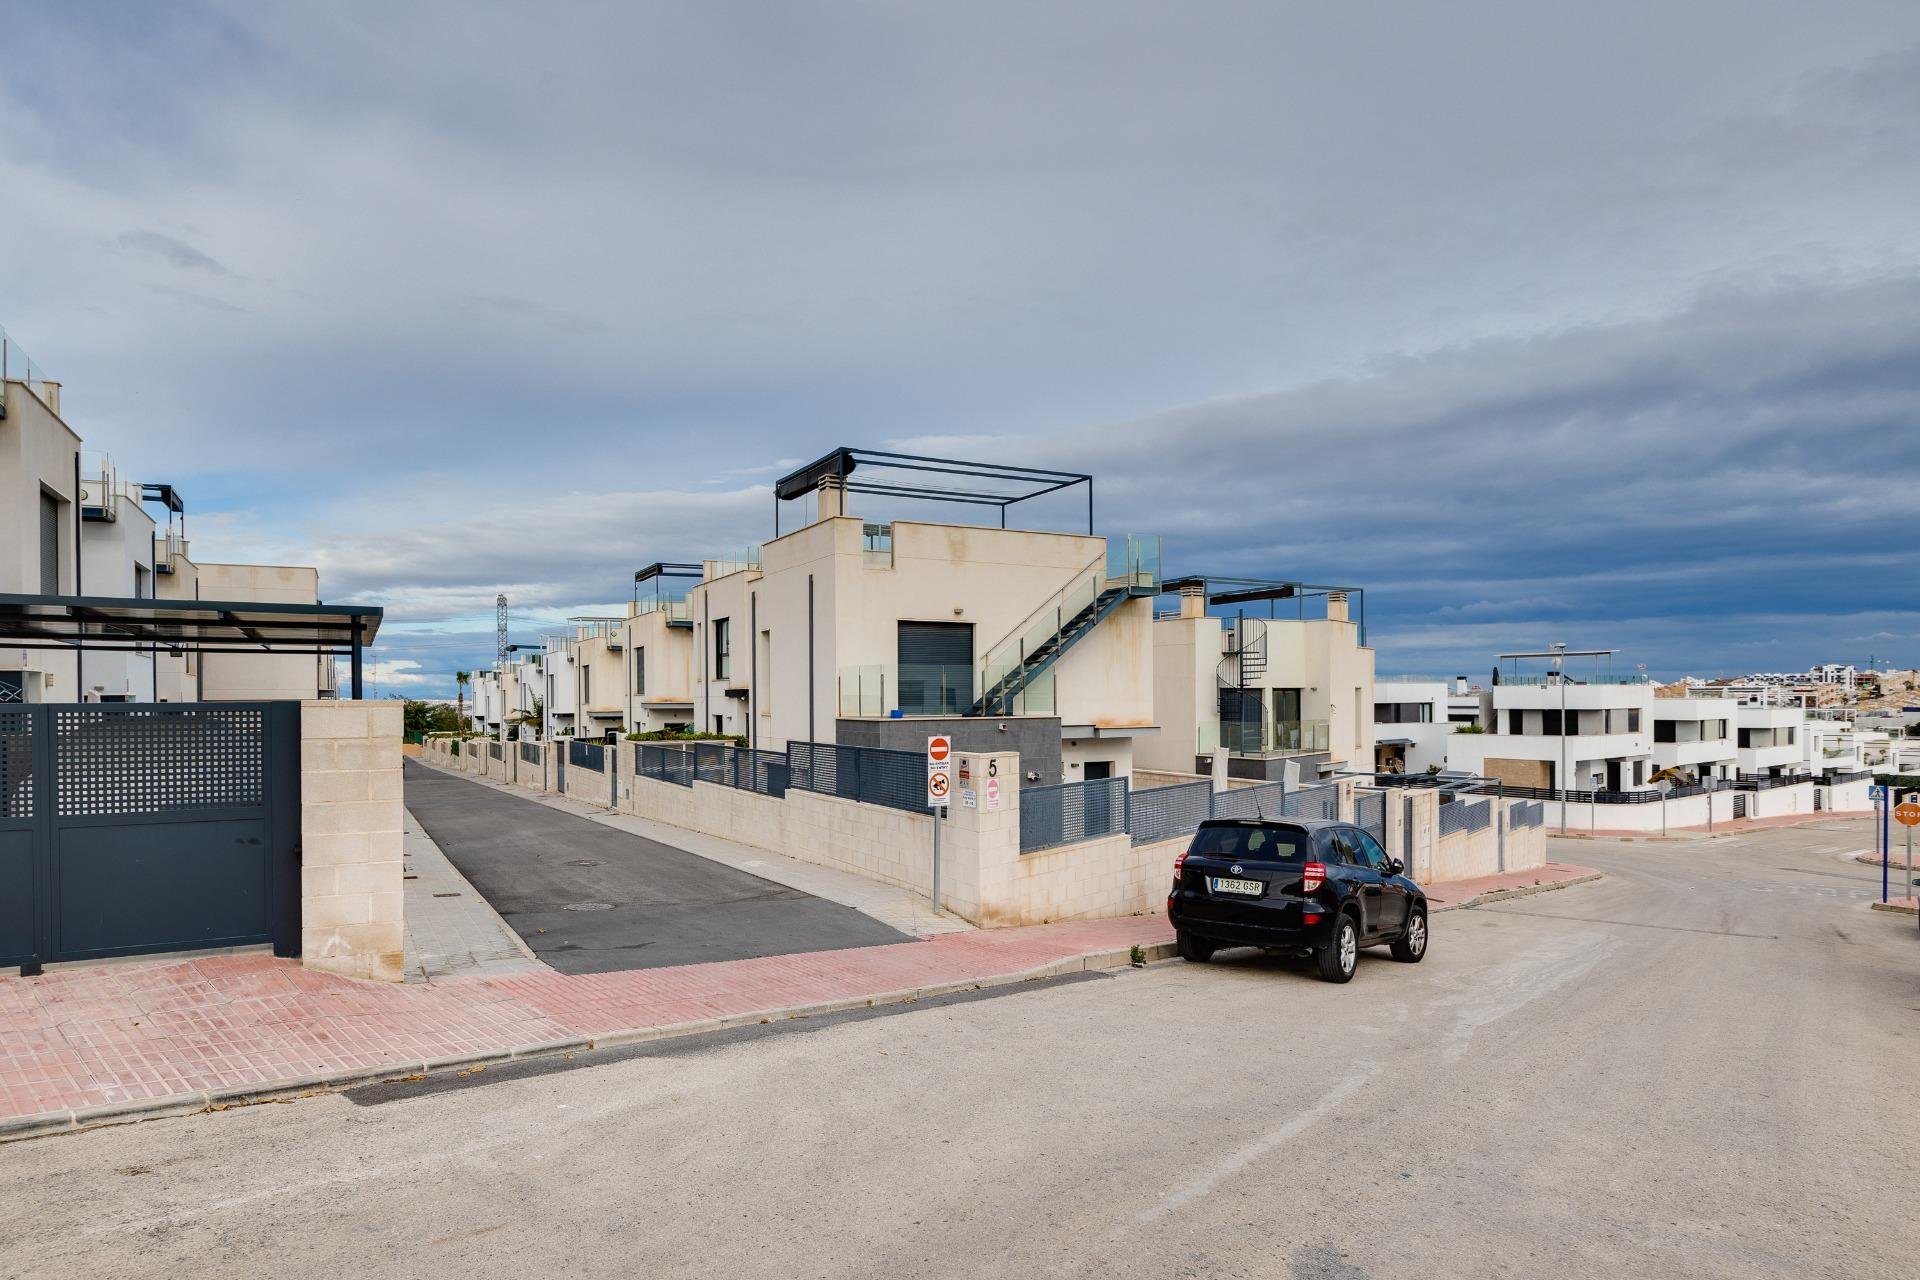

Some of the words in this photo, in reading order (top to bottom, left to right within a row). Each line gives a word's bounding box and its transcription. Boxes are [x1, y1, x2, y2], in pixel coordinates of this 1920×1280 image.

[989, 759, 997, 777] 5
[1220, 879, 1241, 890] 1362
[1243, 881, 1260, 892] GSR
